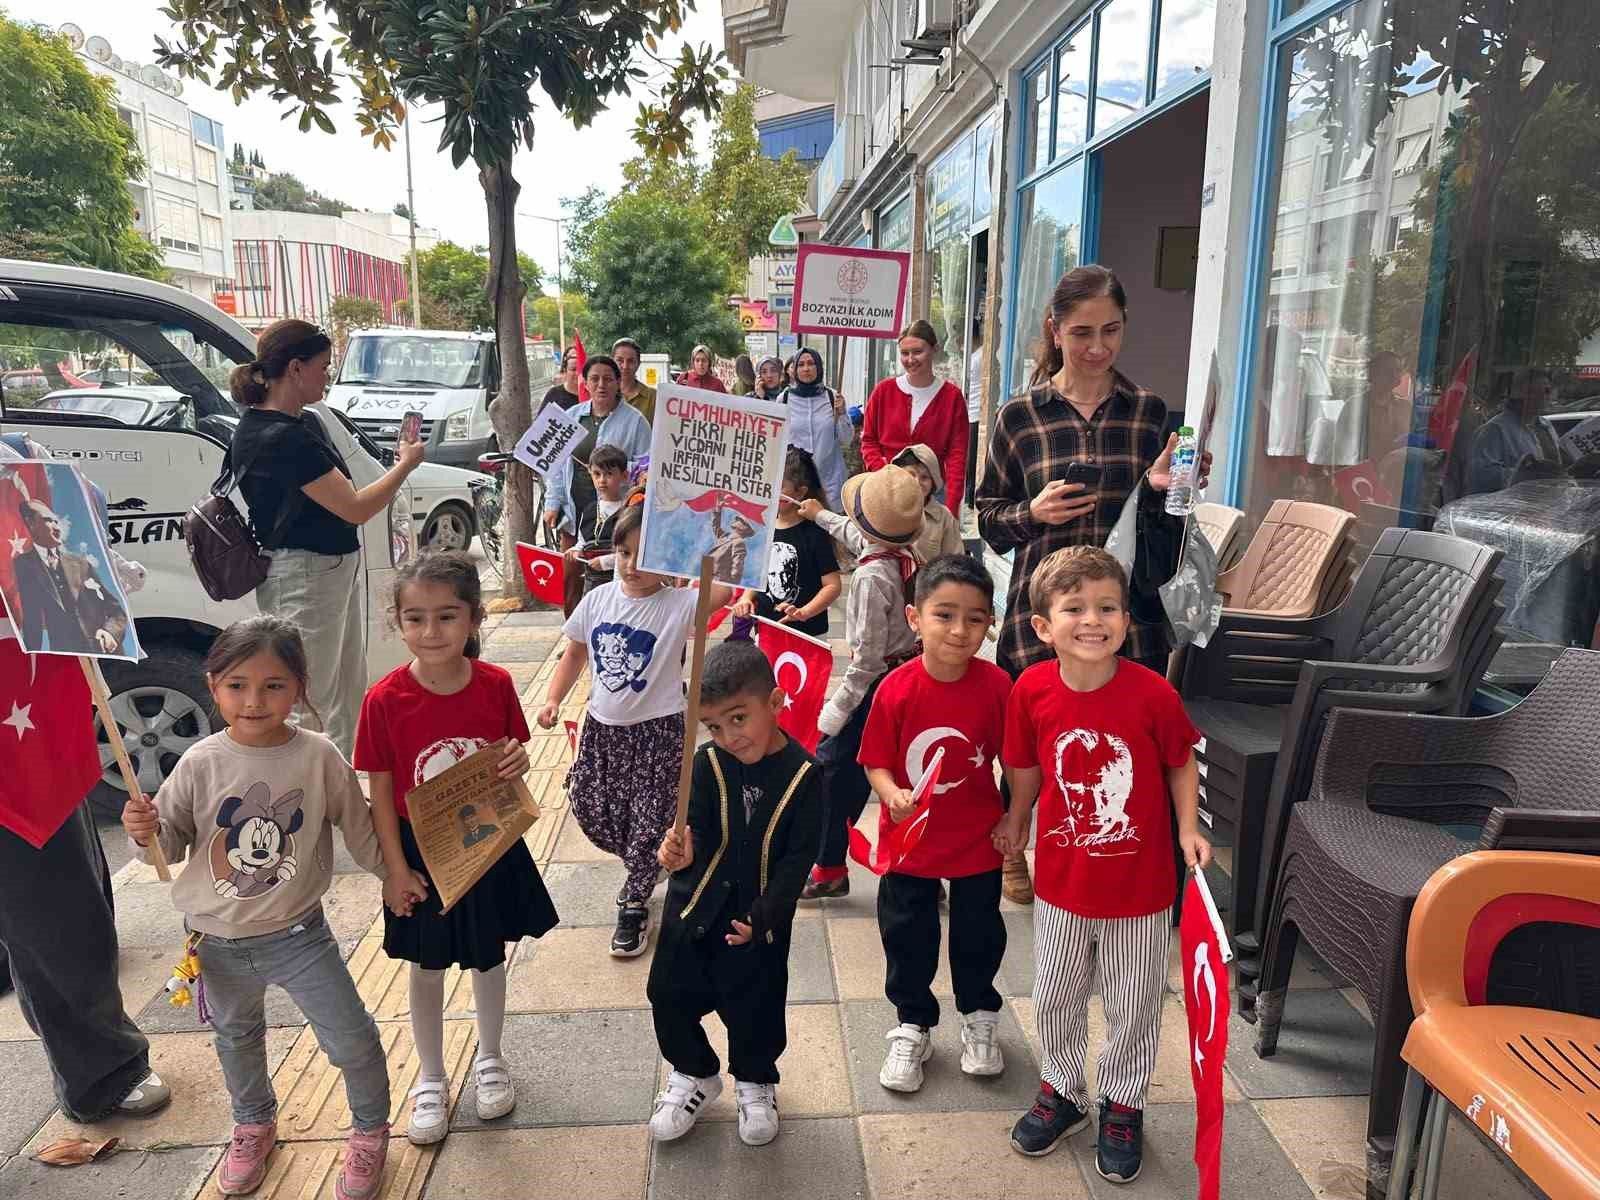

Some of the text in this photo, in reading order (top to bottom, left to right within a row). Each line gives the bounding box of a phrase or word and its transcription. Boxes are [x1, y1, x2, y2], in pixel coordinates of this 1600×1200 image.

[775, 264, 796, 277] AY
[801, 303, 847, 315] BOZYAZI
[848, 303, 865, 316] İLK
[817, 316, 876, 328] ANAOKULU
[526, 418, 563, 457] Umut
[48, 448, 101, 460] 500
[536, 423, 578, 473] Demektir.
[108, 519, 185, 545] SLAN
